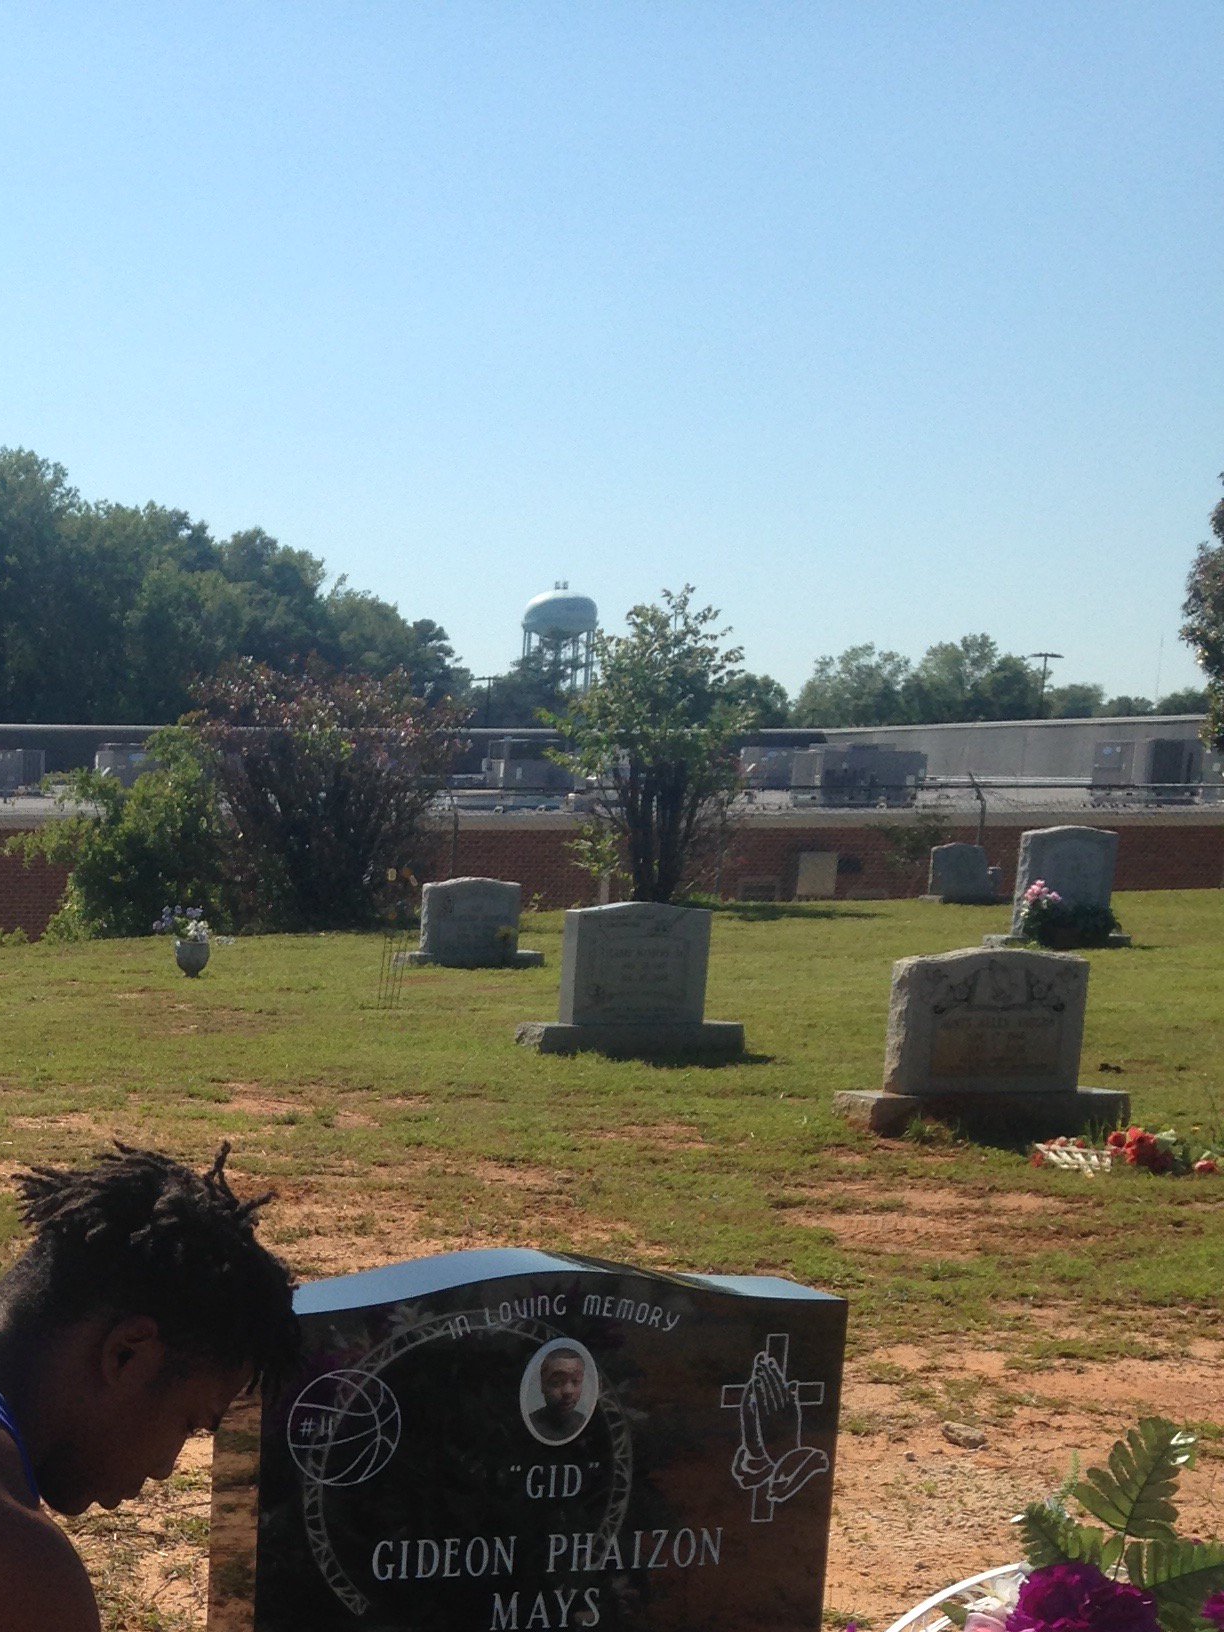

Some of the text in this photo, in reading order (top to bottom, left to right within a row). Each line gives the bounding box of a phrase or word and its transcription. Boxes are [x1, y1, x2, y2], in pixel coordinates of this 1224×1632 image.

[448, 1293, 681, 1340] IN LOVING MEMORY
[371, 1526, 724, 1581] GIDEON PHAIZON
[489, 1586, 602, 1632] MAYS
